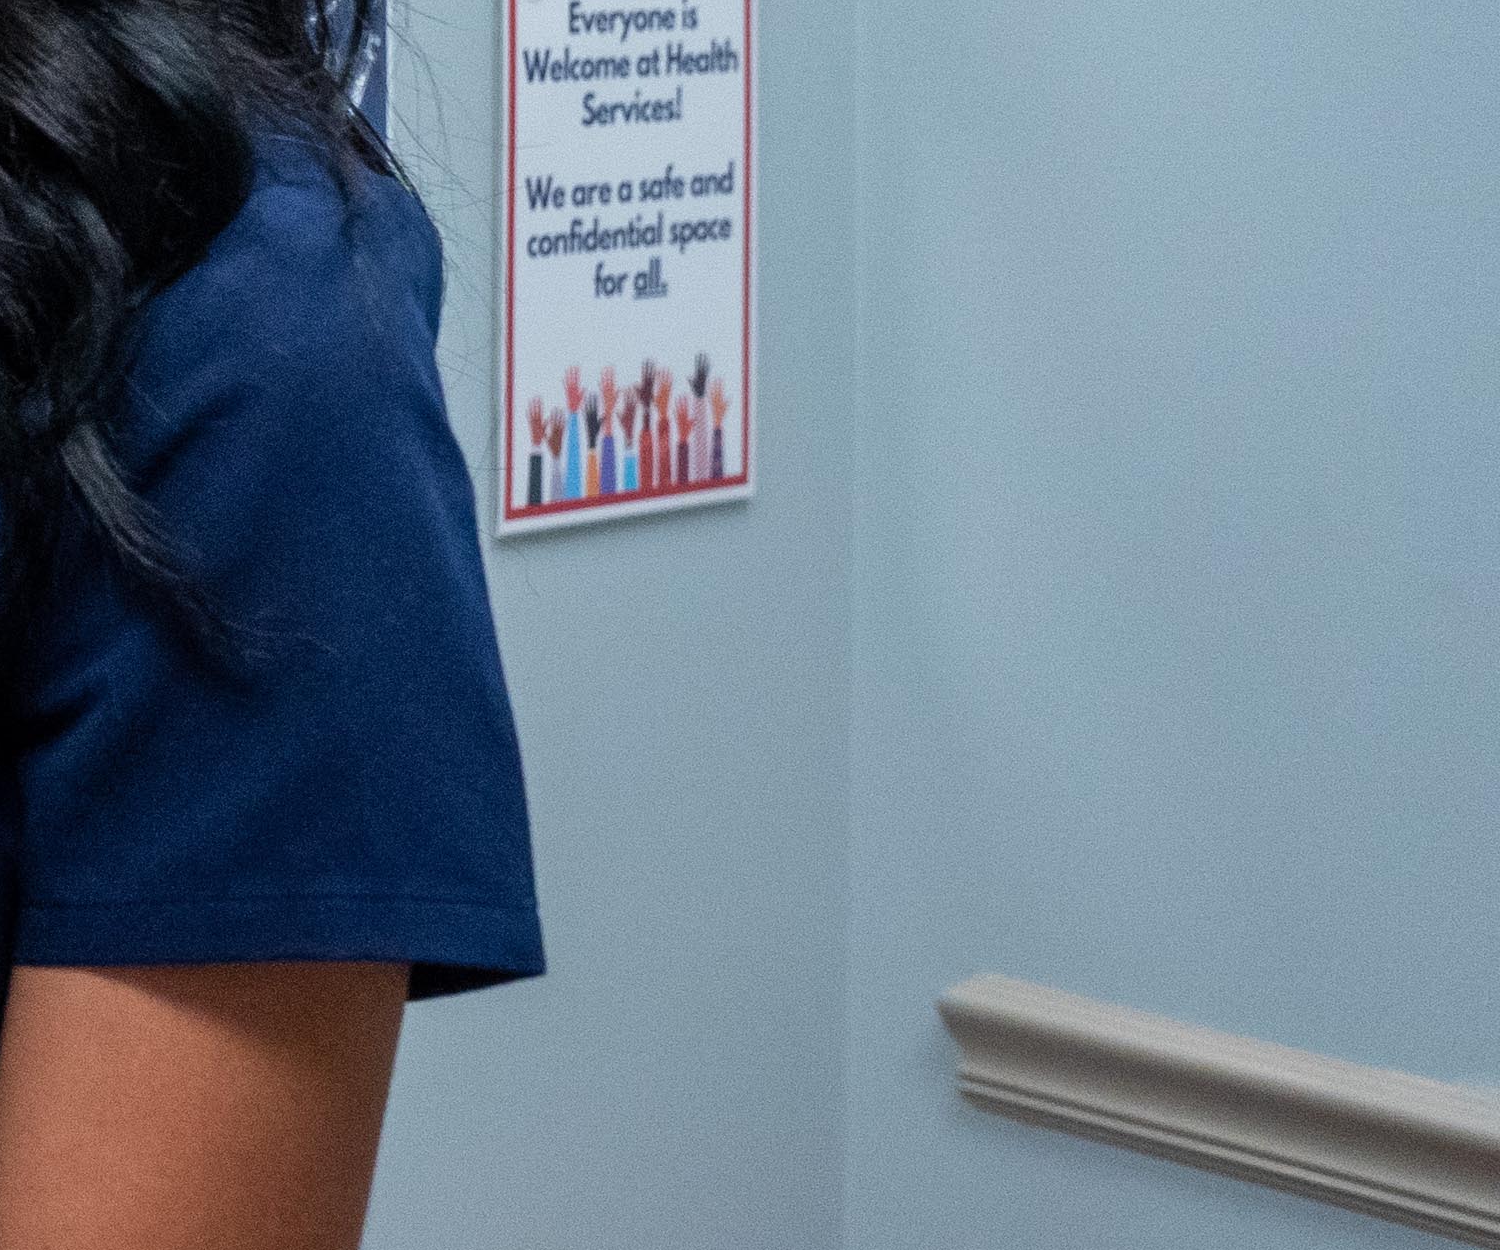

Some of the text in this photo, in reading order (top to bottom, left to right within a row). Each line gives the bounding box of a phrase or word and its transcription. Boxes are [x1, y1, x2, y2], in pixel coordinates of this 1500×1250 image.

[567, 0, 676, 43] Everyone
[523, 37, 739, 84] Welcome at Health
[581, 85, 683, 128] Services!
[525, 159, 735, 211] We are a safe and
[526, 210, 733, 258] confidential space
[594, 255, 668, 298] for all.
